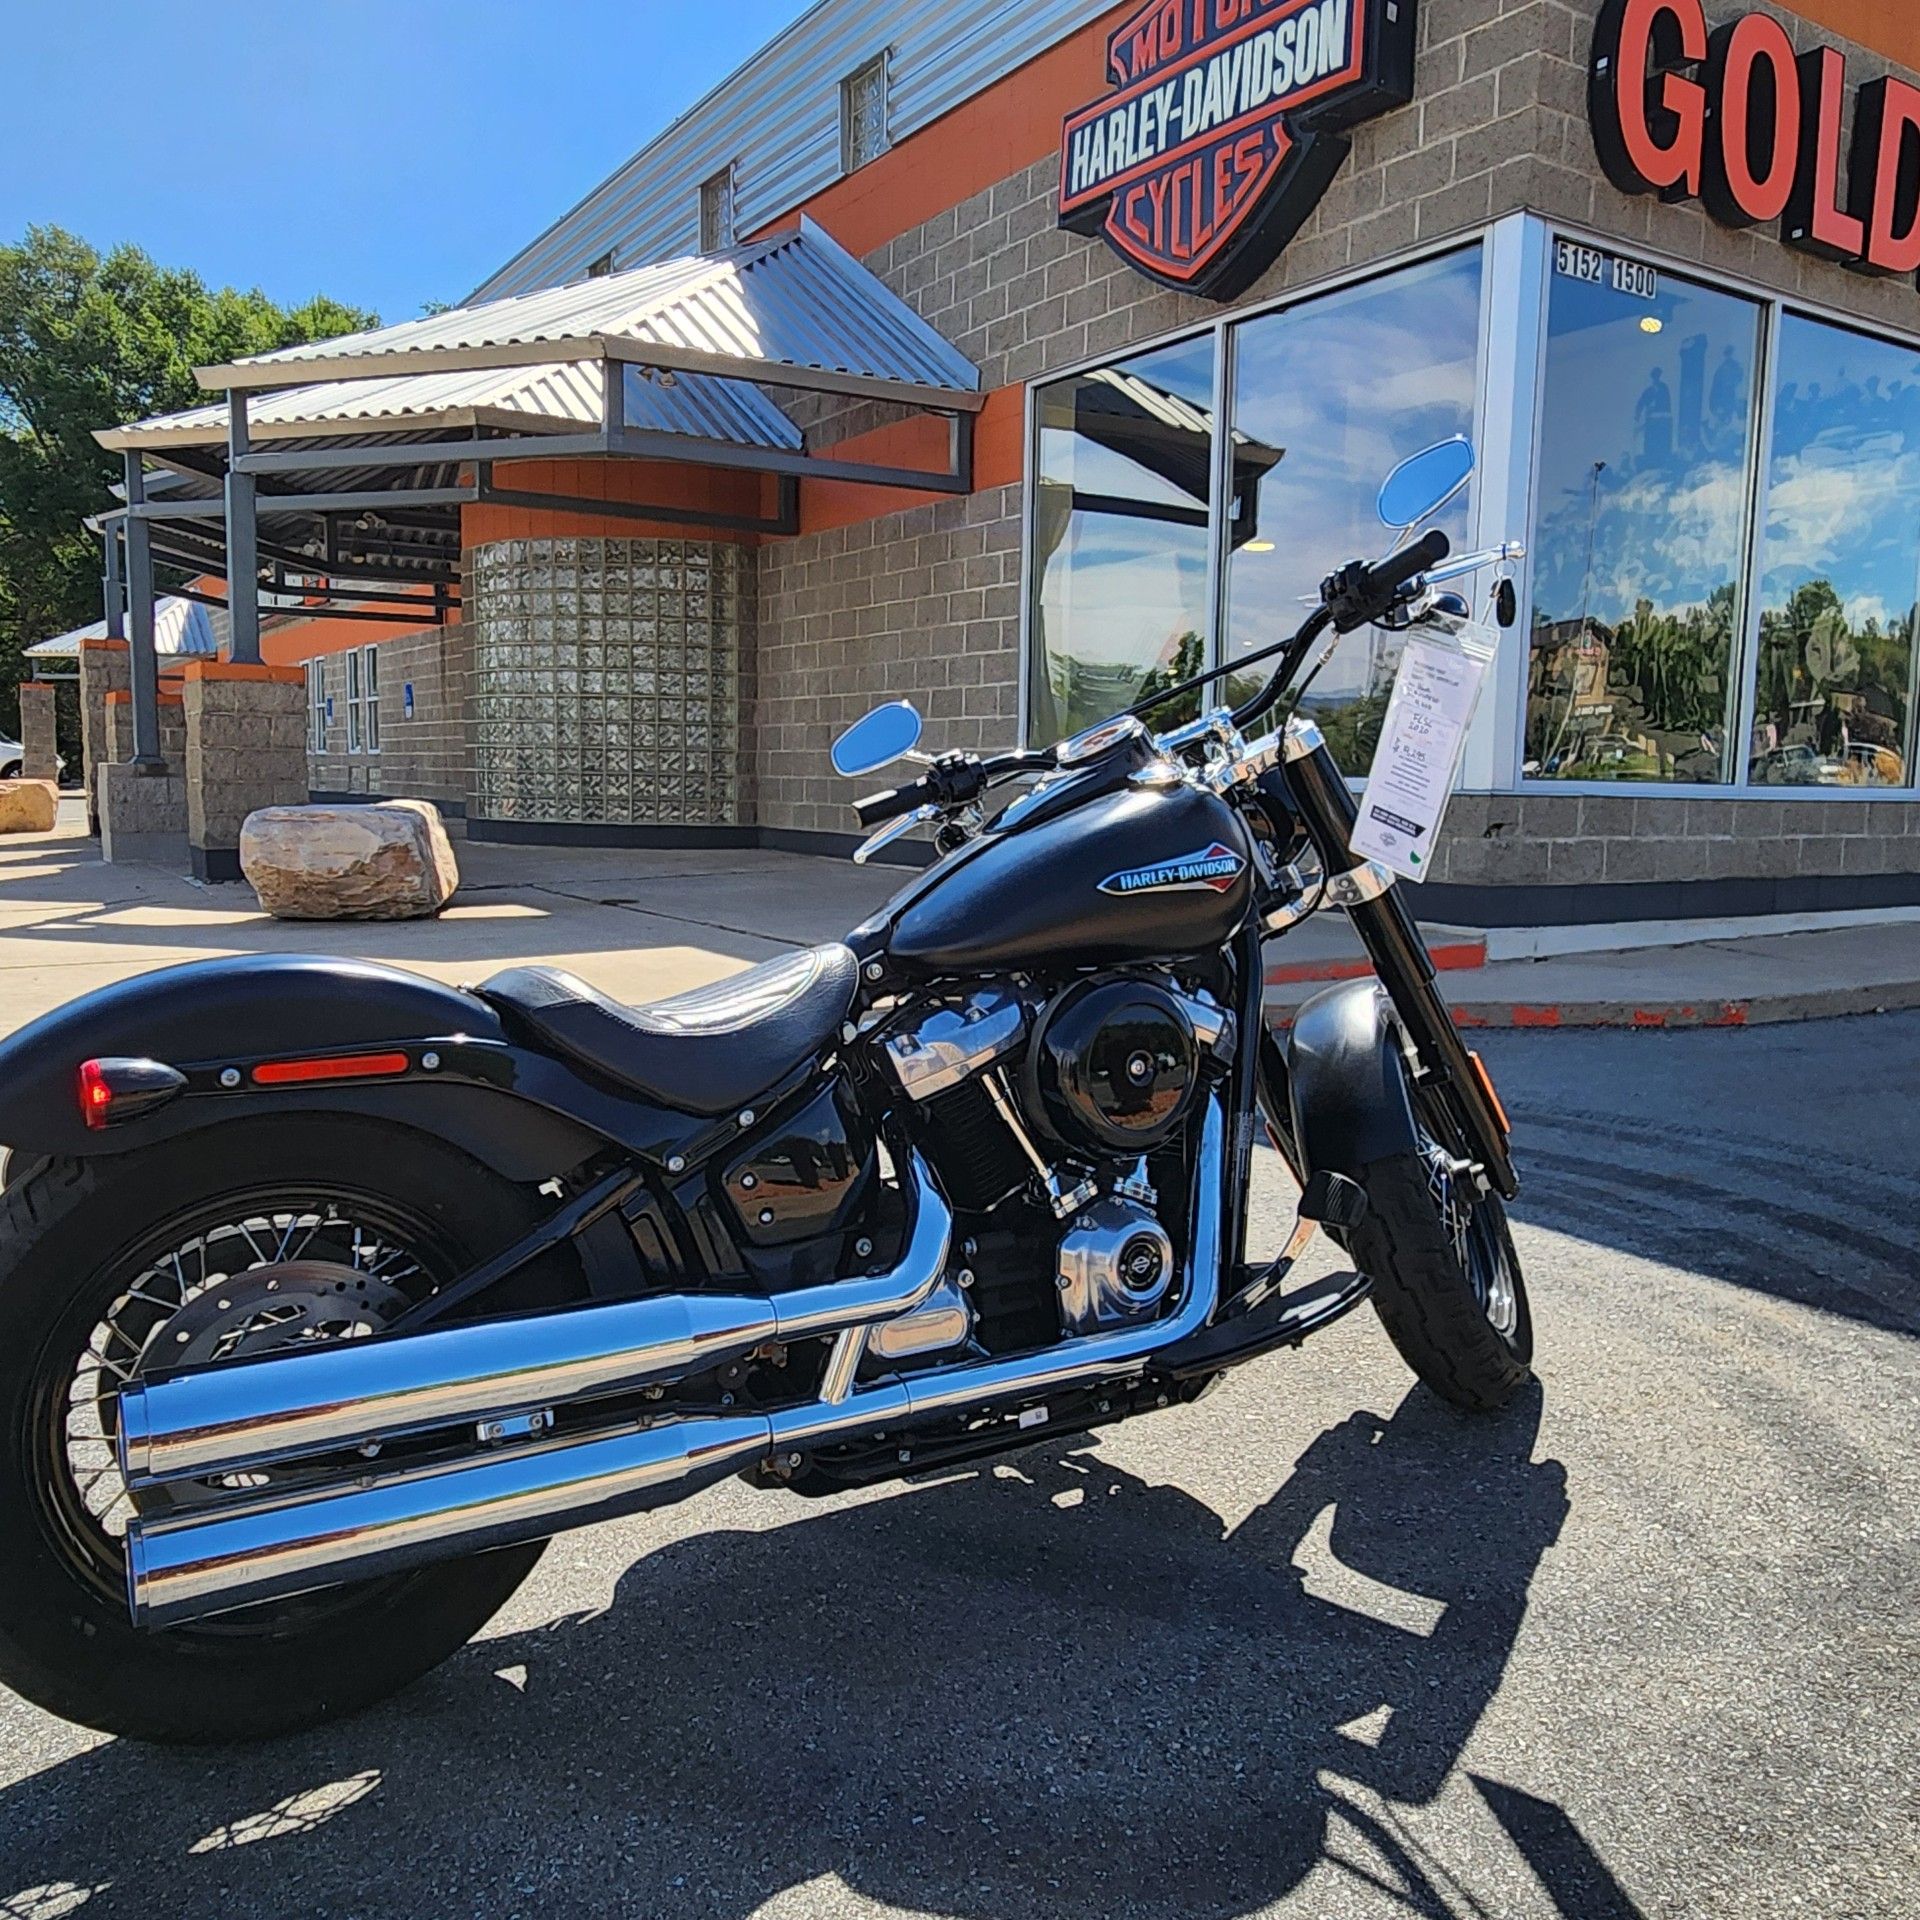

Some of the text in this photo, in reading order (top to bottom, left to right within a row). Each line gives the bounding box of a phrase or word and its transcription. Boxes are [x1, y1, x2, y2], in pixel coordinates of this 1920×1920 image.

[1131, 0, 1274, 78] MOT
[1071, 0, 1347, 194] HARLEY-DAVIDSON
[1617, 0, 1920, 272] GOLD
[1125, 130, 1264, 259] CYCLES
[1558, 243, 1656, 297] 5152 1500
[1121, 860, 1236, 889] HARLEY-DAVIDSON
